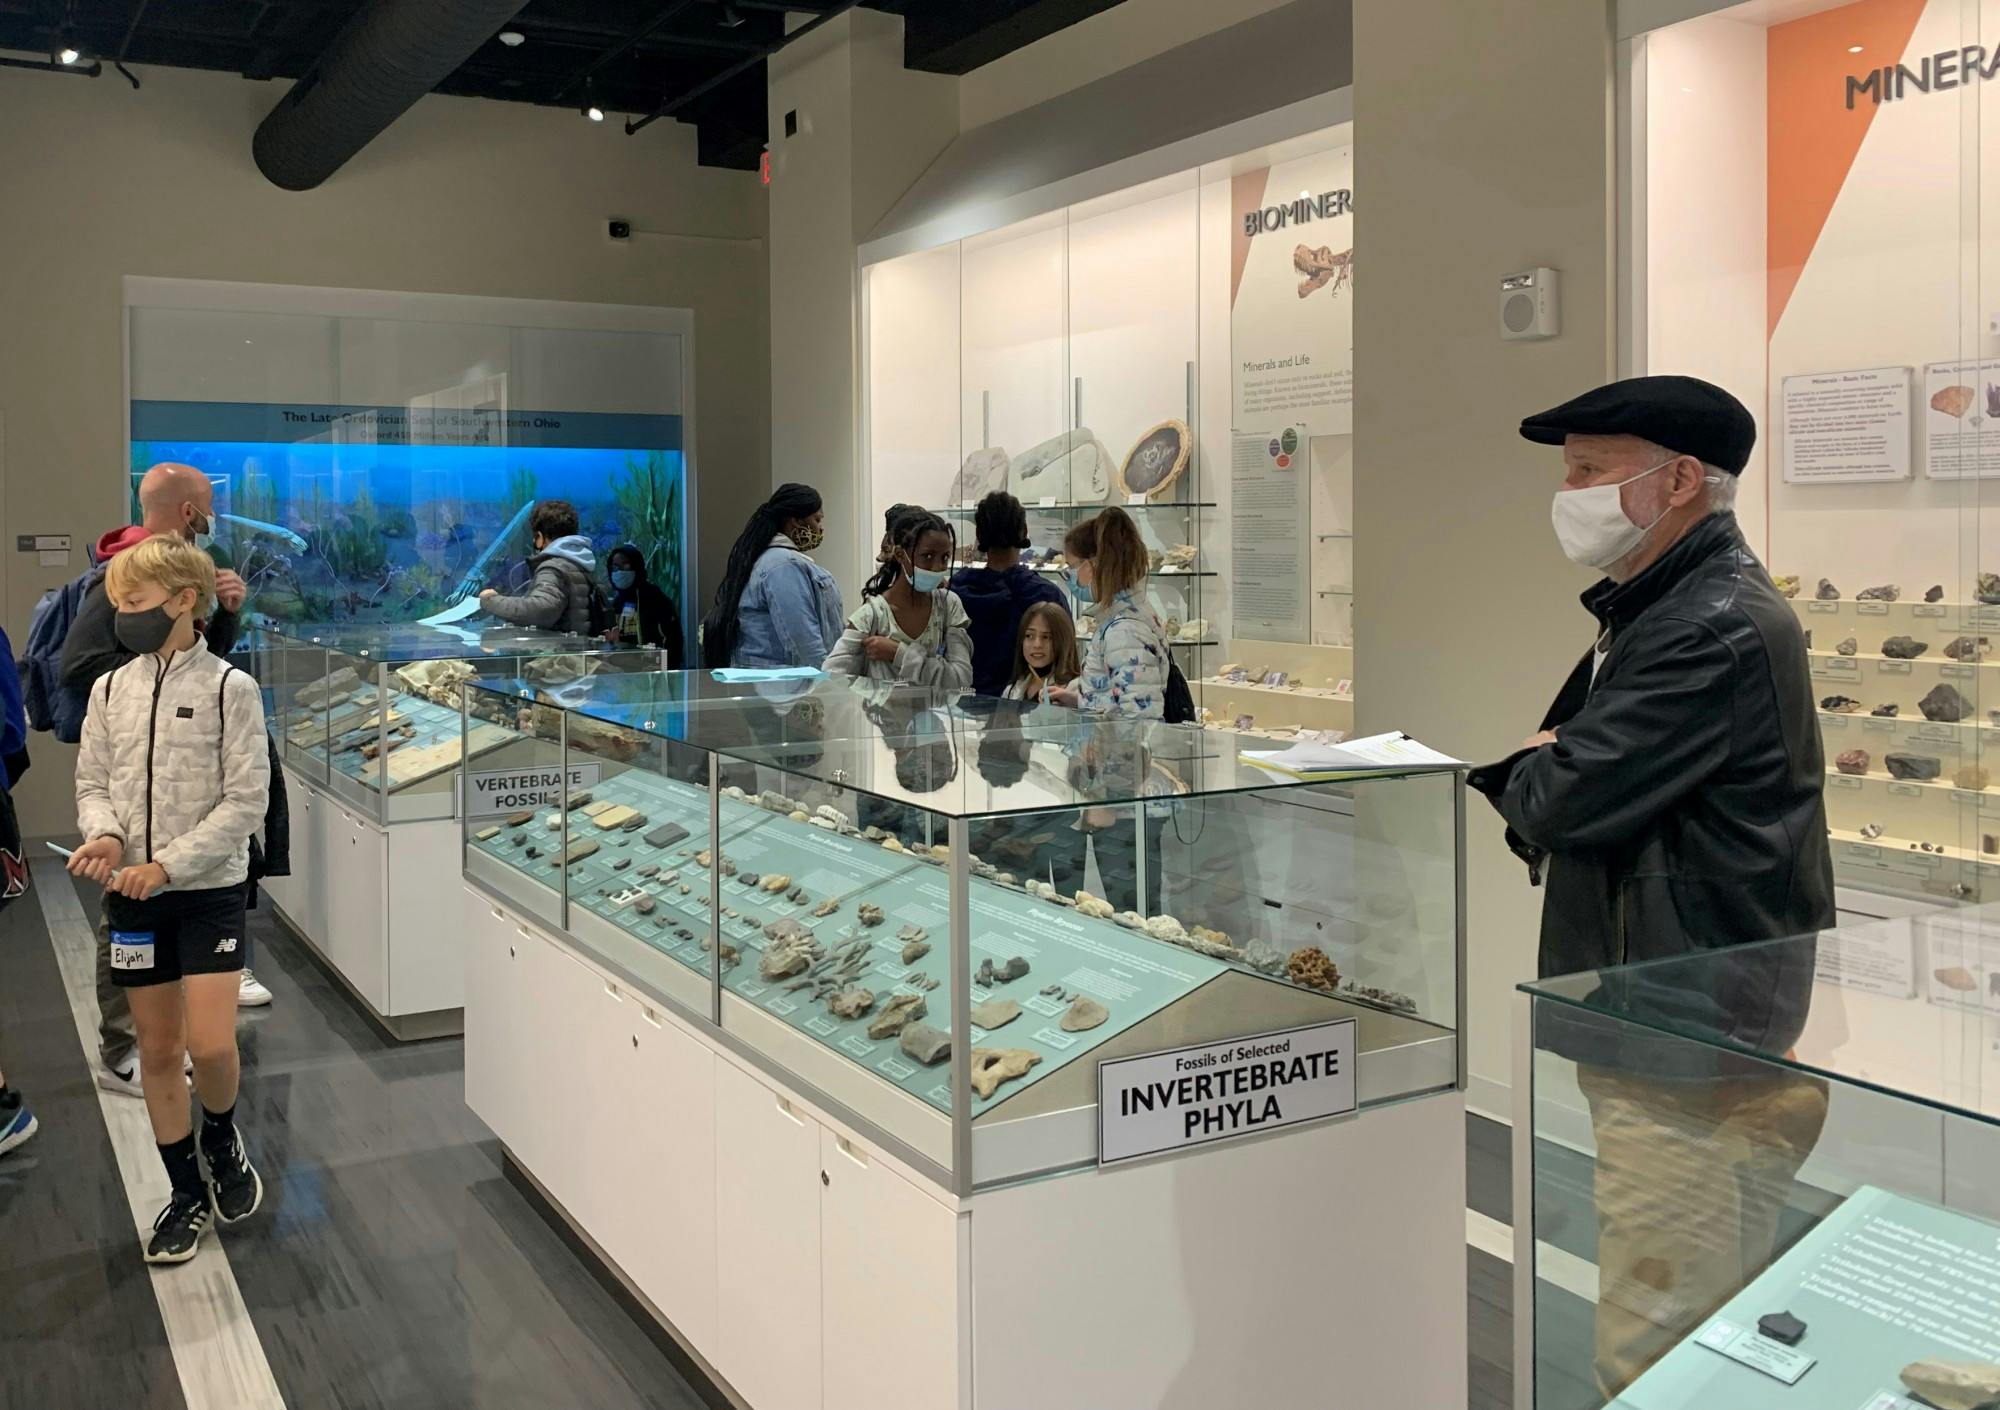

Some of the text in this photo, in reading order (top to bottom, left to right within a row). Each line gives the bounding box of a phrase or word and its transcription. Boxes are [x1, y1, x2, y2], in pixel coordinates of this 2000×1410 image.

[1244, 188, 1353, 237] BIOMINER
[1243, 354, 1311, 373] Minerals and Life
[282, 411, 307, 424] The
[310, 411, 336, 424] Late
[342, 412, 406, 426] Ordovician
[533, 417, 561, 430] Ohio
[495, 789, 561, 808] FOSSIL
[115, 948, 144, 968] Elijah
[1176, 1039, 1291, 1072] Fossils of Selected
[1121, 1049, 1339, 1116] INVERTEBRATE
[1184, 1094, 1283, 1138] PHYLA
